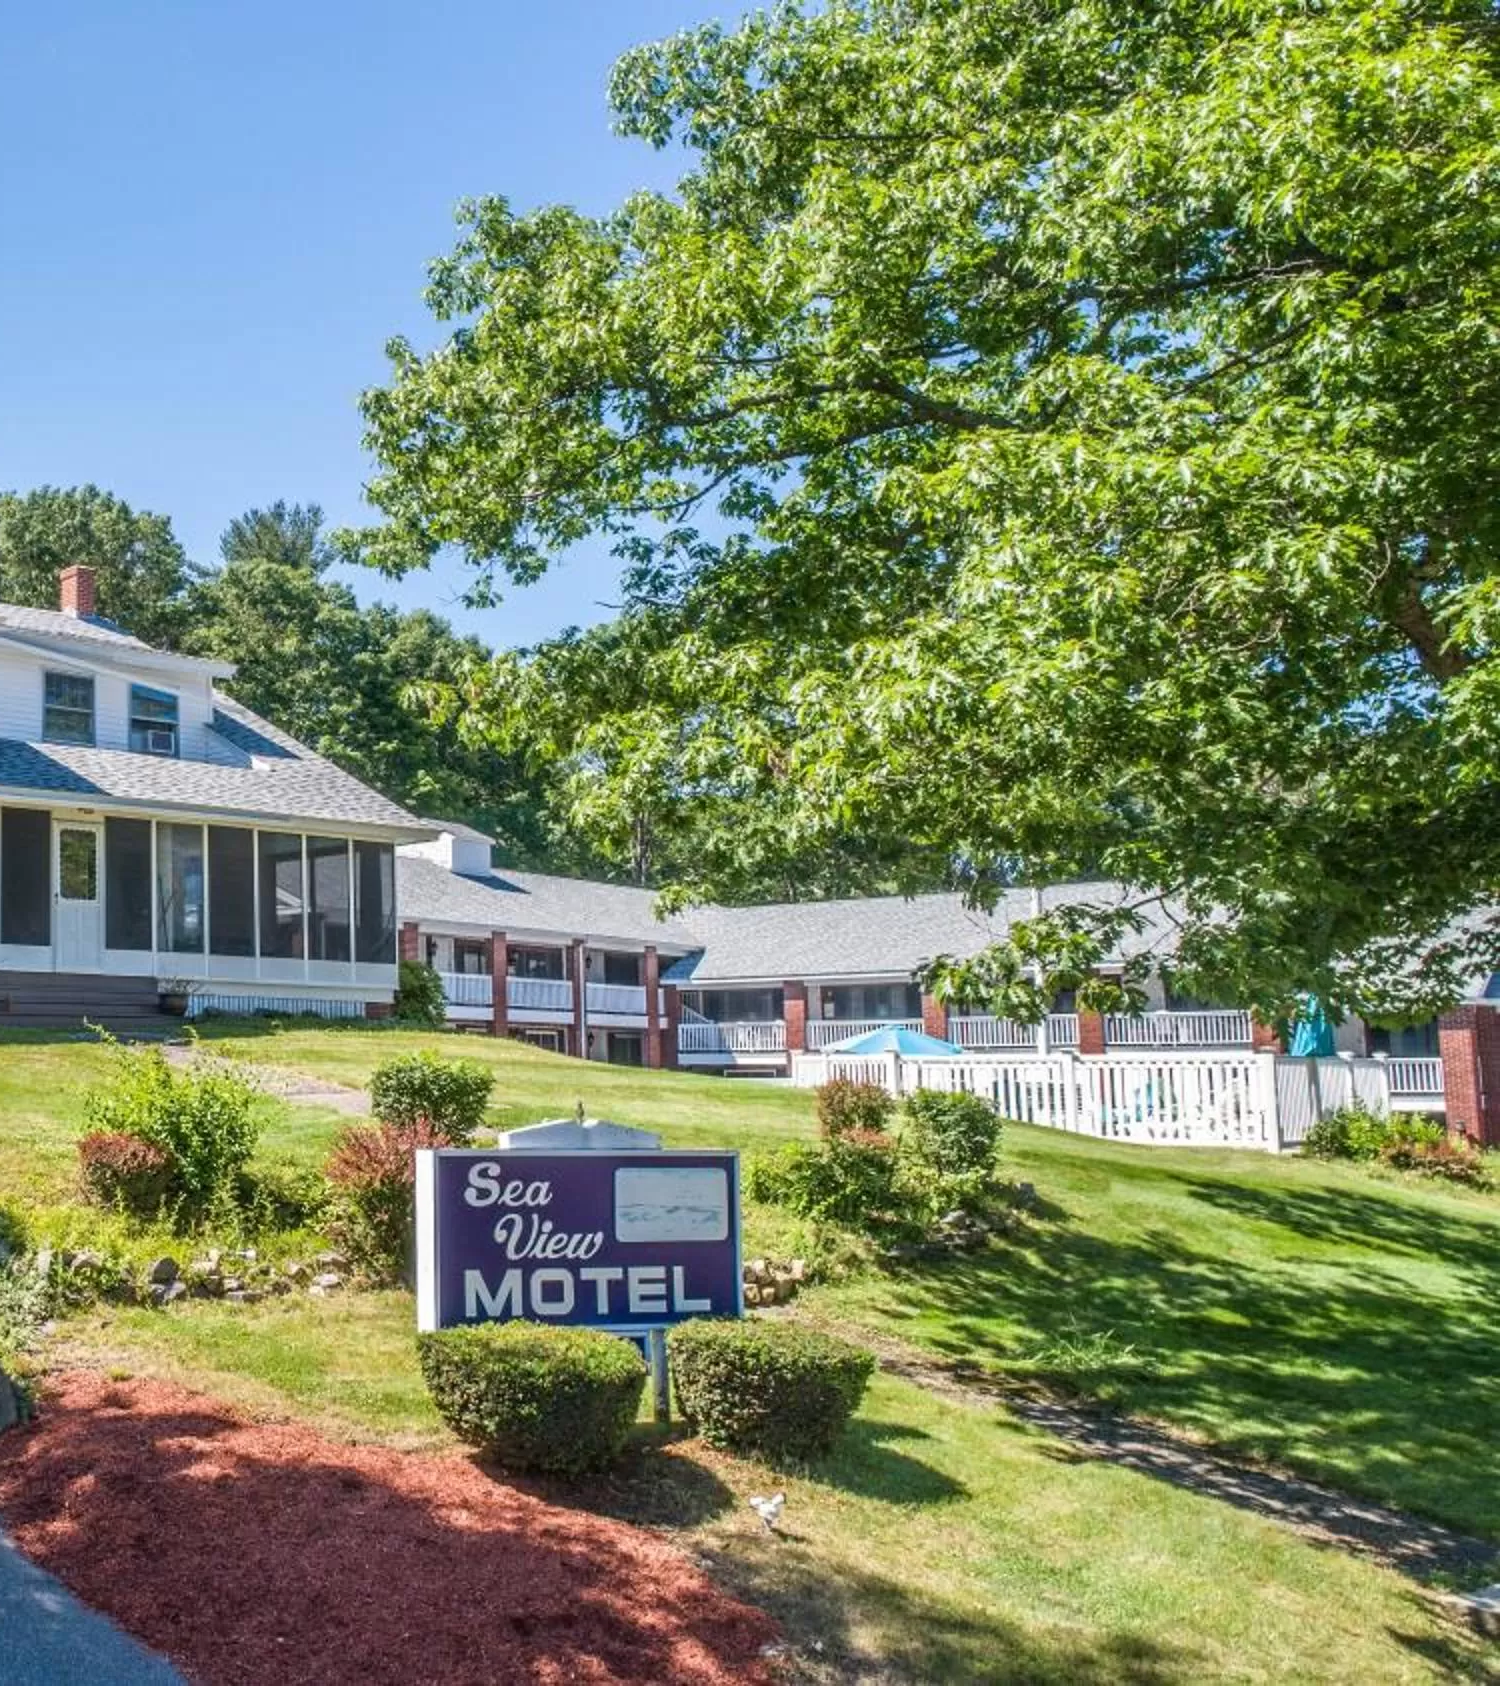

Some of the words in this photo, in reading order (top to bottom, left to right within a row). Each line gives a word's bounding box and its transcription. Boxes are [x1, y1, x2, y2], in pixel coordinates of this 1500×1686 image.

[463, 1161, 553, 1207] Sea
[494, 1213, 604, 1260] View
[464, 1266, 712, 1318] MOTEL
